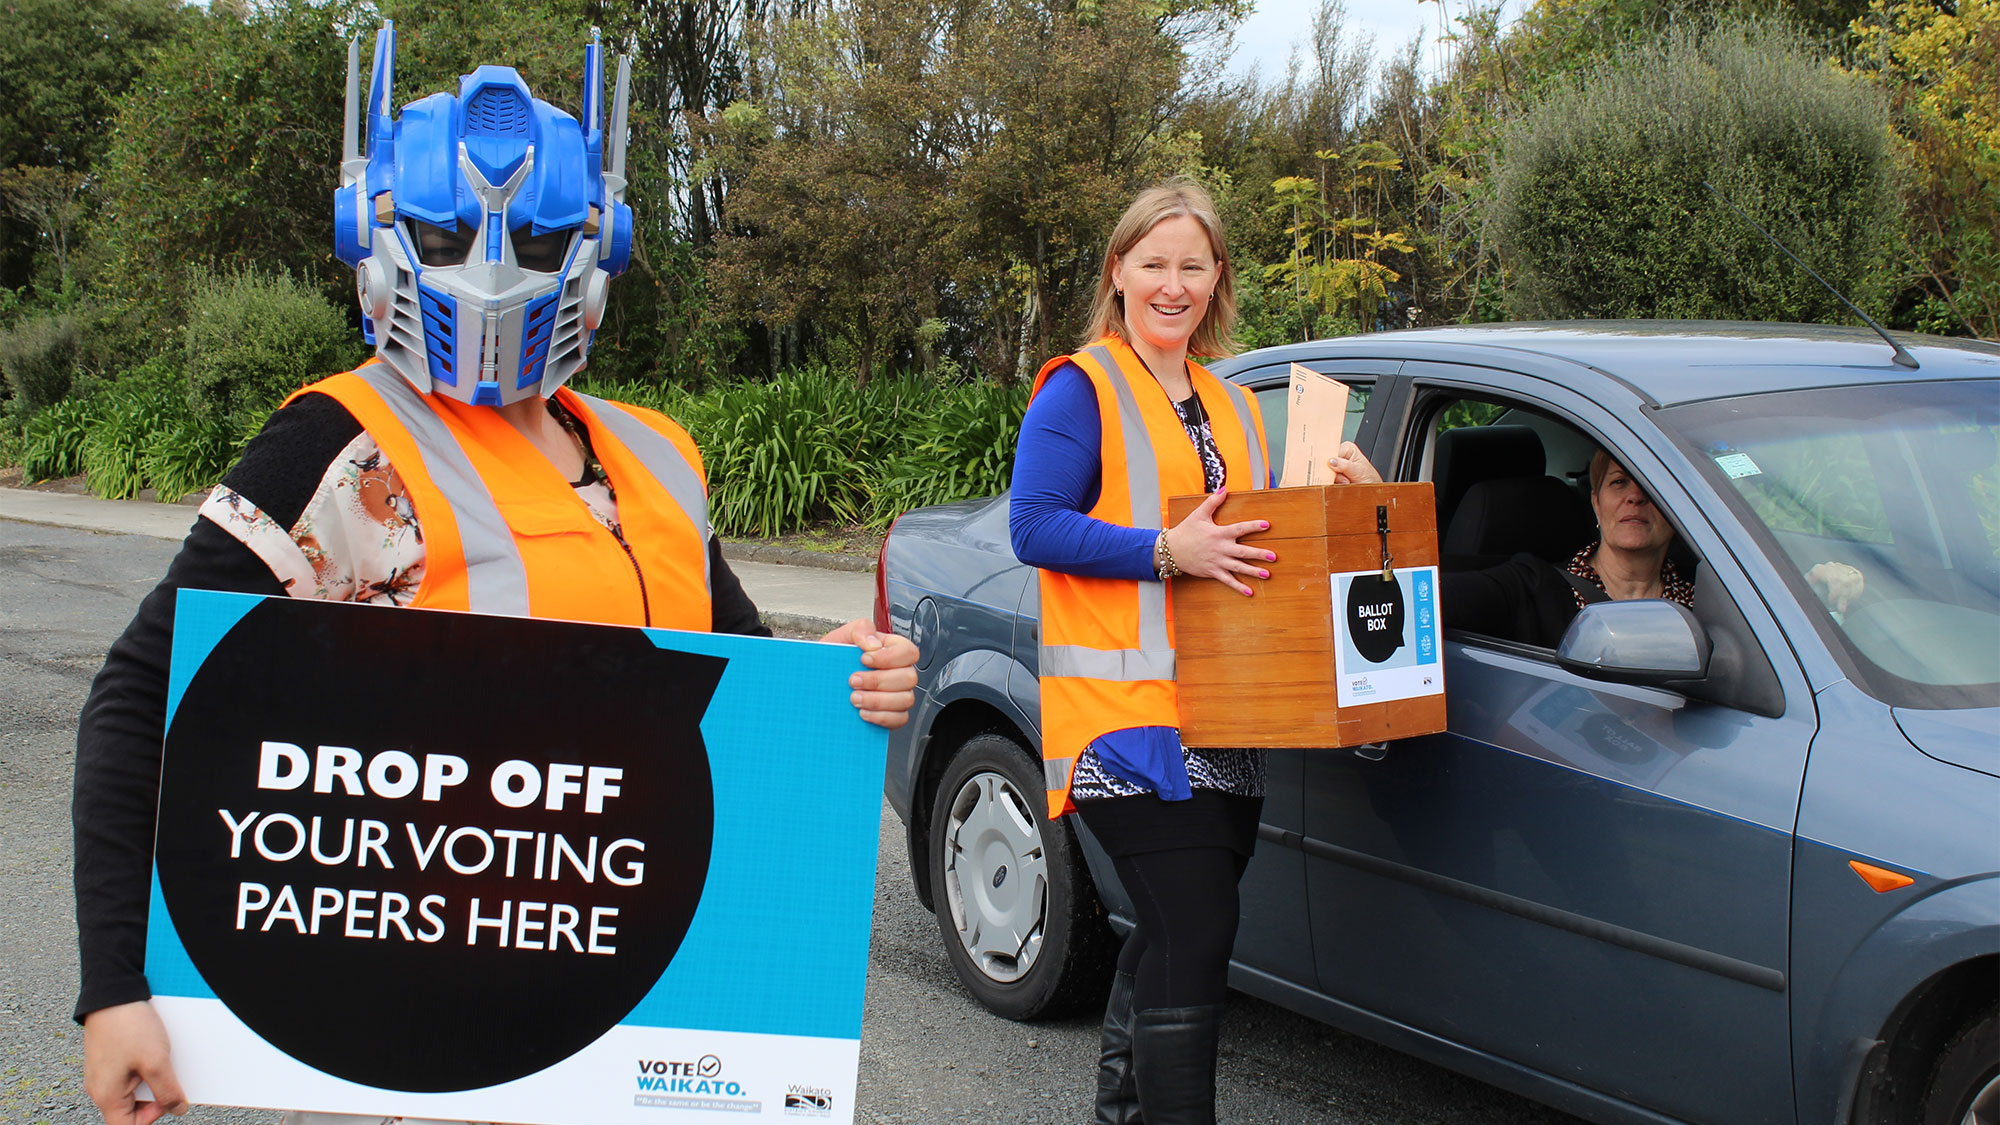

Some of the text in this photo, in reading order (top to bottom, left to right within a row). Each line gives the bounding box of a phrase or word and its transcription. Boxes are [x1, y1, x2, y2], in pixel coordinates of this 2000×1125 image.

[1358, 602, 1394, 618] BALLOT
[1367, 618, 1387, 631] BOX
[257, 741, 624, 814] DROP OFF
[218, 809, 645, 887] YOUR VOTING
[236, 881, 619, 955] PAPERS HERE
[638, 1059, 695, 1077] VOTE
[636, 1076, 747, 1096] WAIKATO.
[787, 1084, 832, 1096] Waikato
[654, 1098, 667, 1106] the
[701, 1100, 710, 1108] be
[712, 1101, 724, 1109] the
